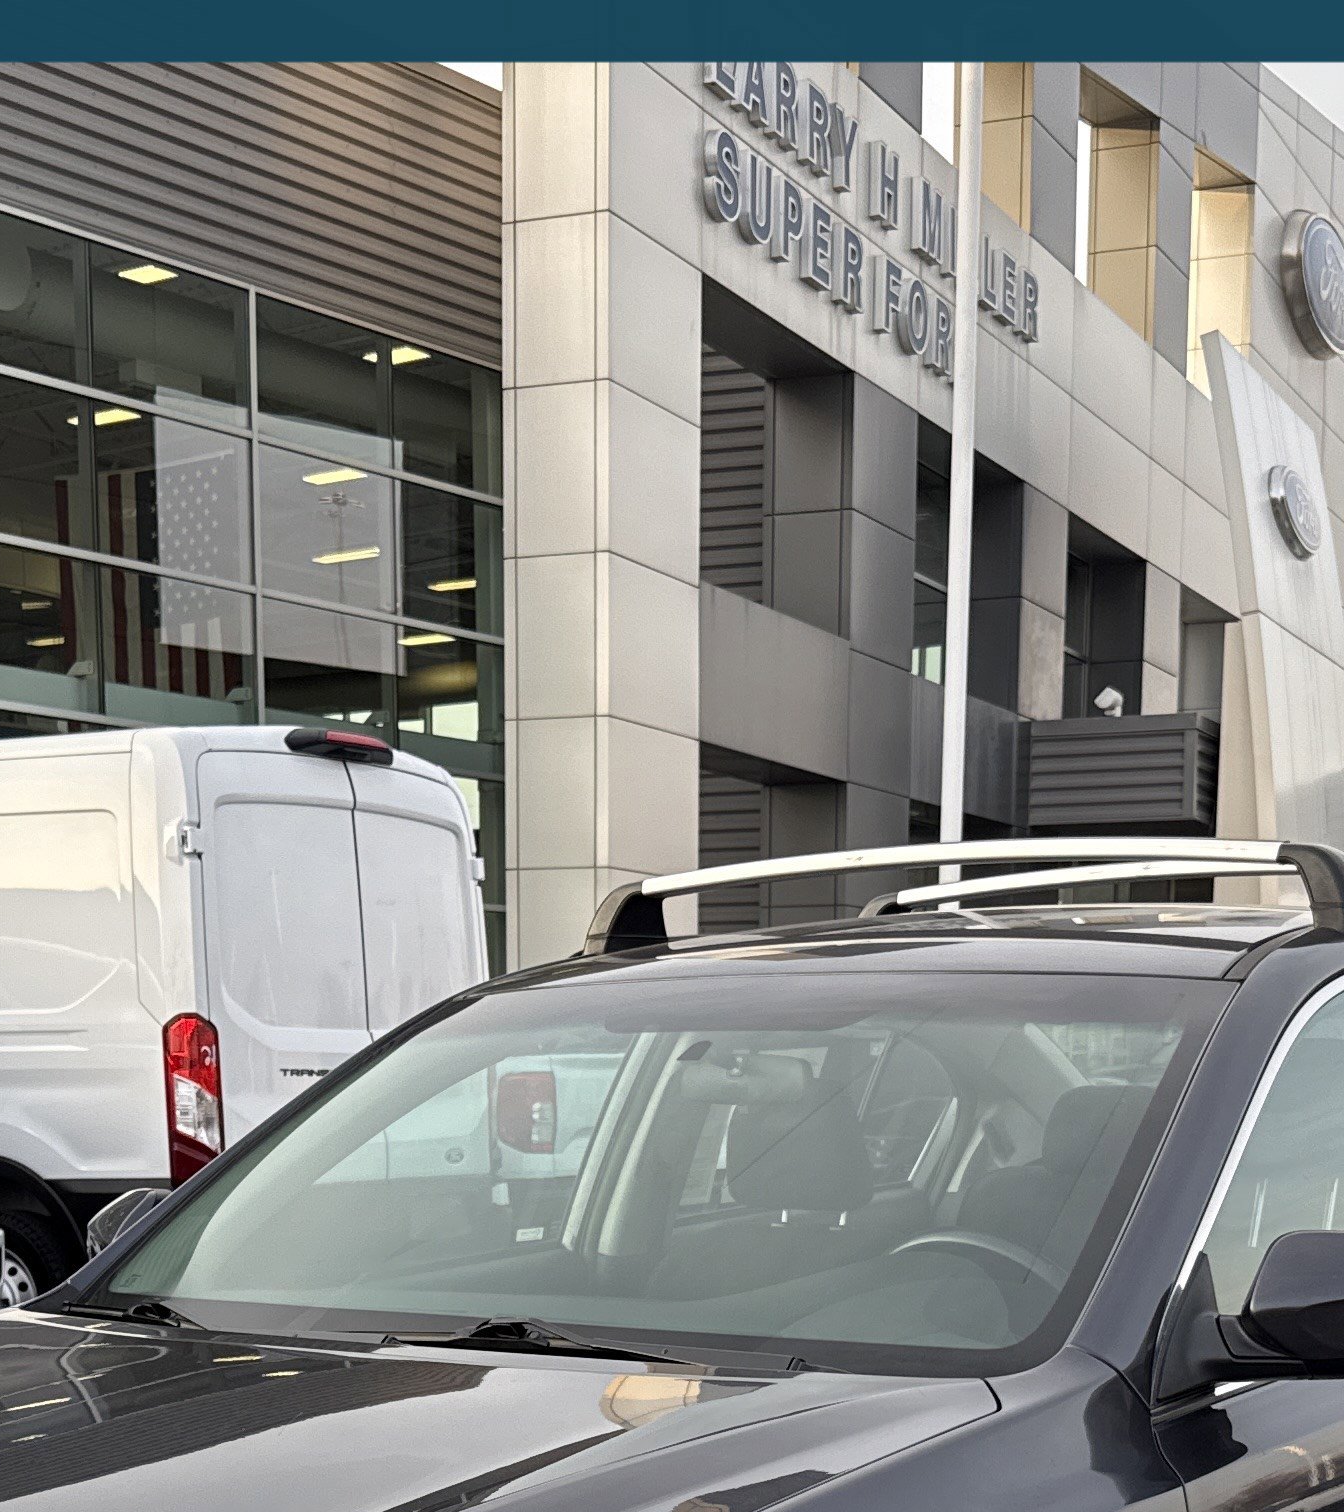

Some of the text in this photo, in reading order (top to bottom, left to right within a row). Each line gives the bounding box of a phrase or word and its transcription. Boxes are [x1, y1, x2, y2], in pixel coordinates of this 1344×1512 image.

[704, 129, 954, 387] SUPER FOR
[867, 139, 901, 231] H
[911, 176, 1039, 343] MILER
